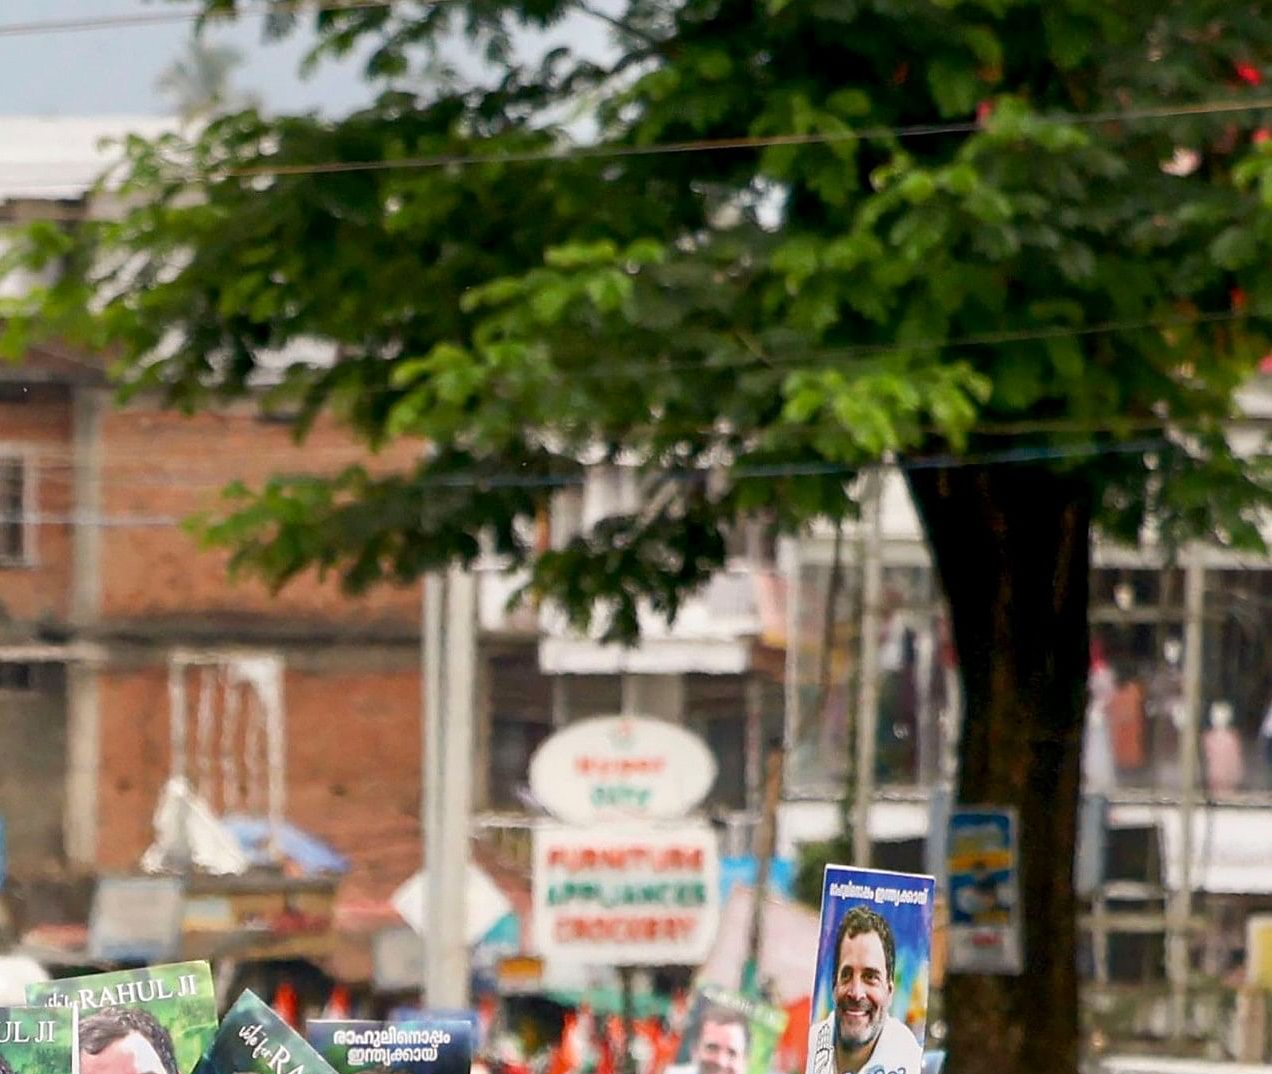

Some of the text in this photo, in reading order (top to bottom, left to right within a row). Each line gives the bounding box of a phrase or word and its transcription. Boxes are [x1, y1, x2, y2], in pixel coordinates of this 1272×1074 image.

[547, 848, 703, 872] FURNITURE
[547, 882, 706, 907] APPLIANCES
[78, 979, 173, 1009] RAHUL
[177, 974, 198, 997] JI
[34, 1021, 55, 1044] JI
